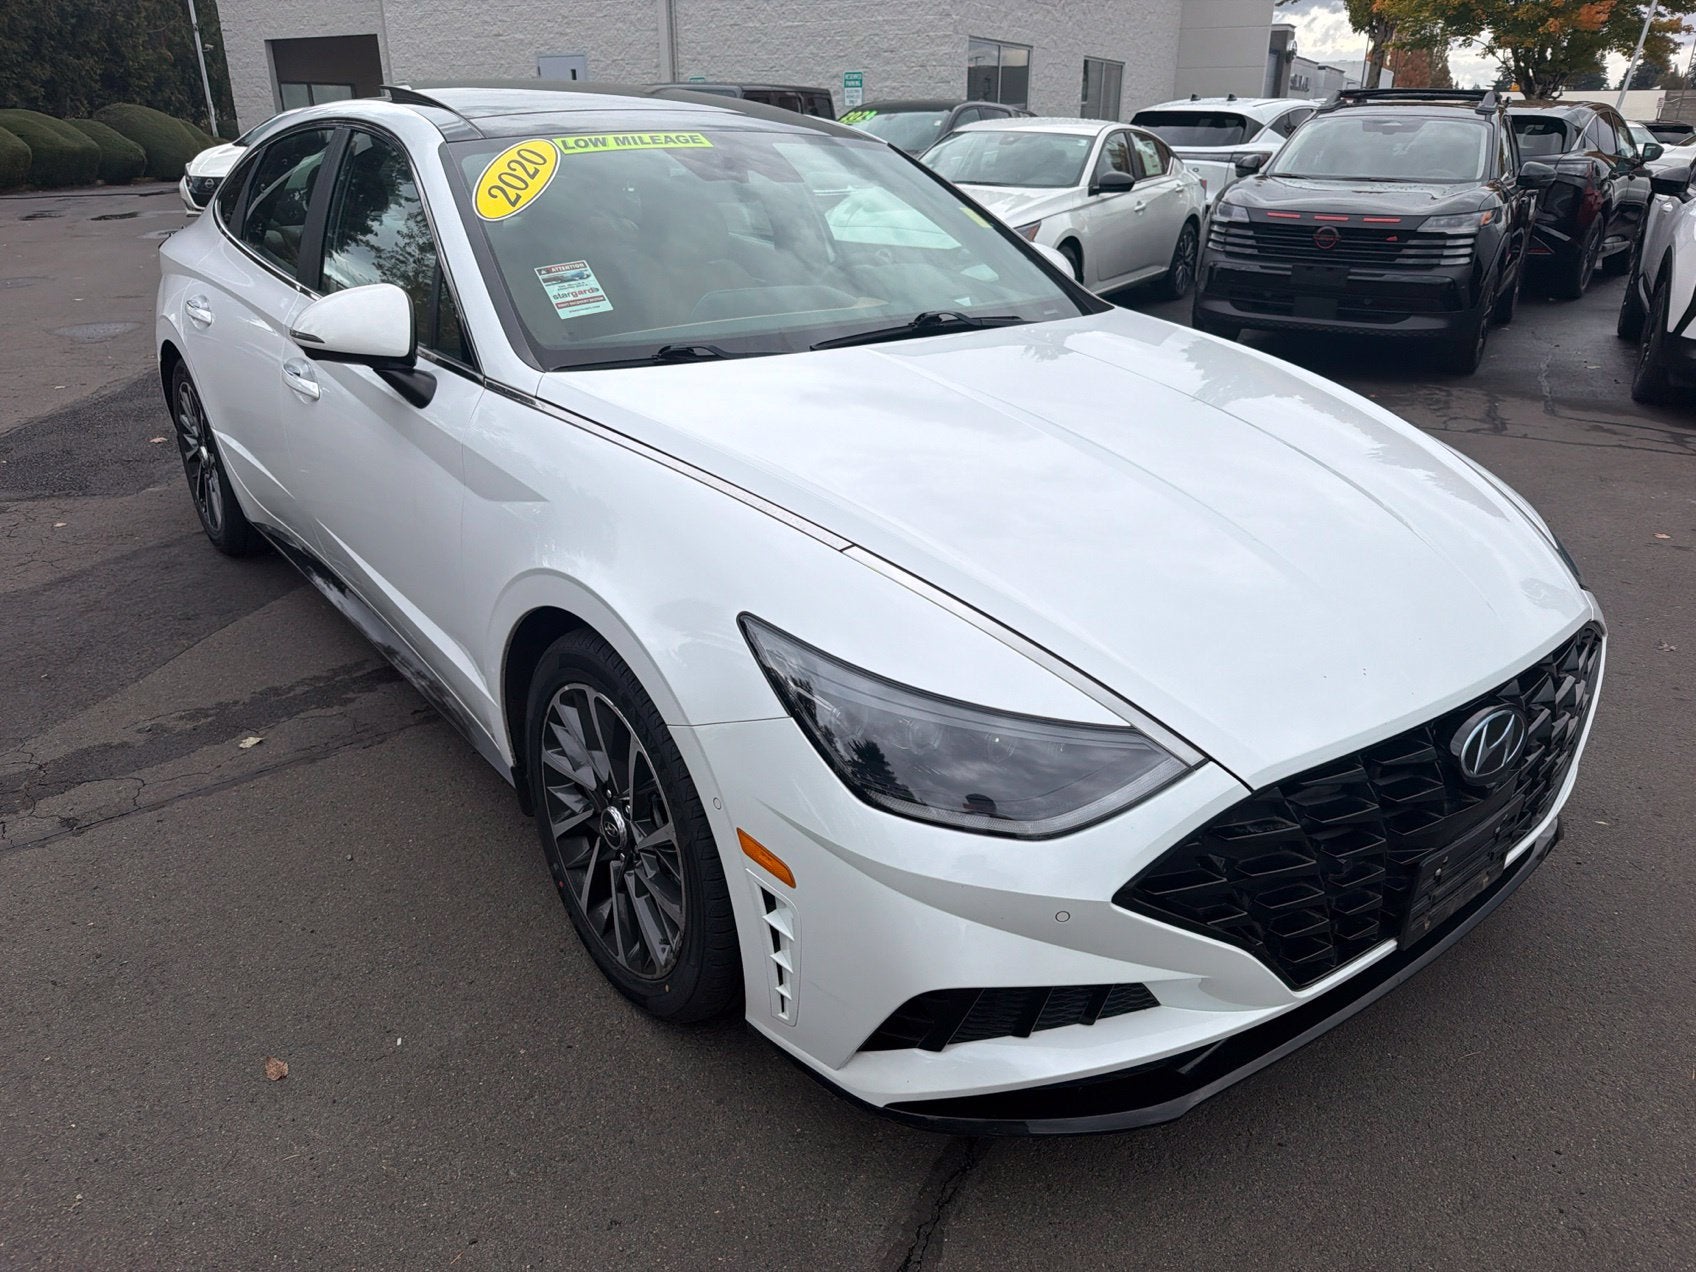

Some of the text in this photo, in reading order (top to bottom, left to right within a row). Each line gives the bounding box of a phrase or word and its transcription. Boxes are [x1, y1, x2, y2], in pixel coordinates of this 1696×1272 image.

[561, 134, 703, 151] LOW MILEAGE
[488, 148, 547, 207] 2020
[551, 263, 584, 272] ATTENTION
